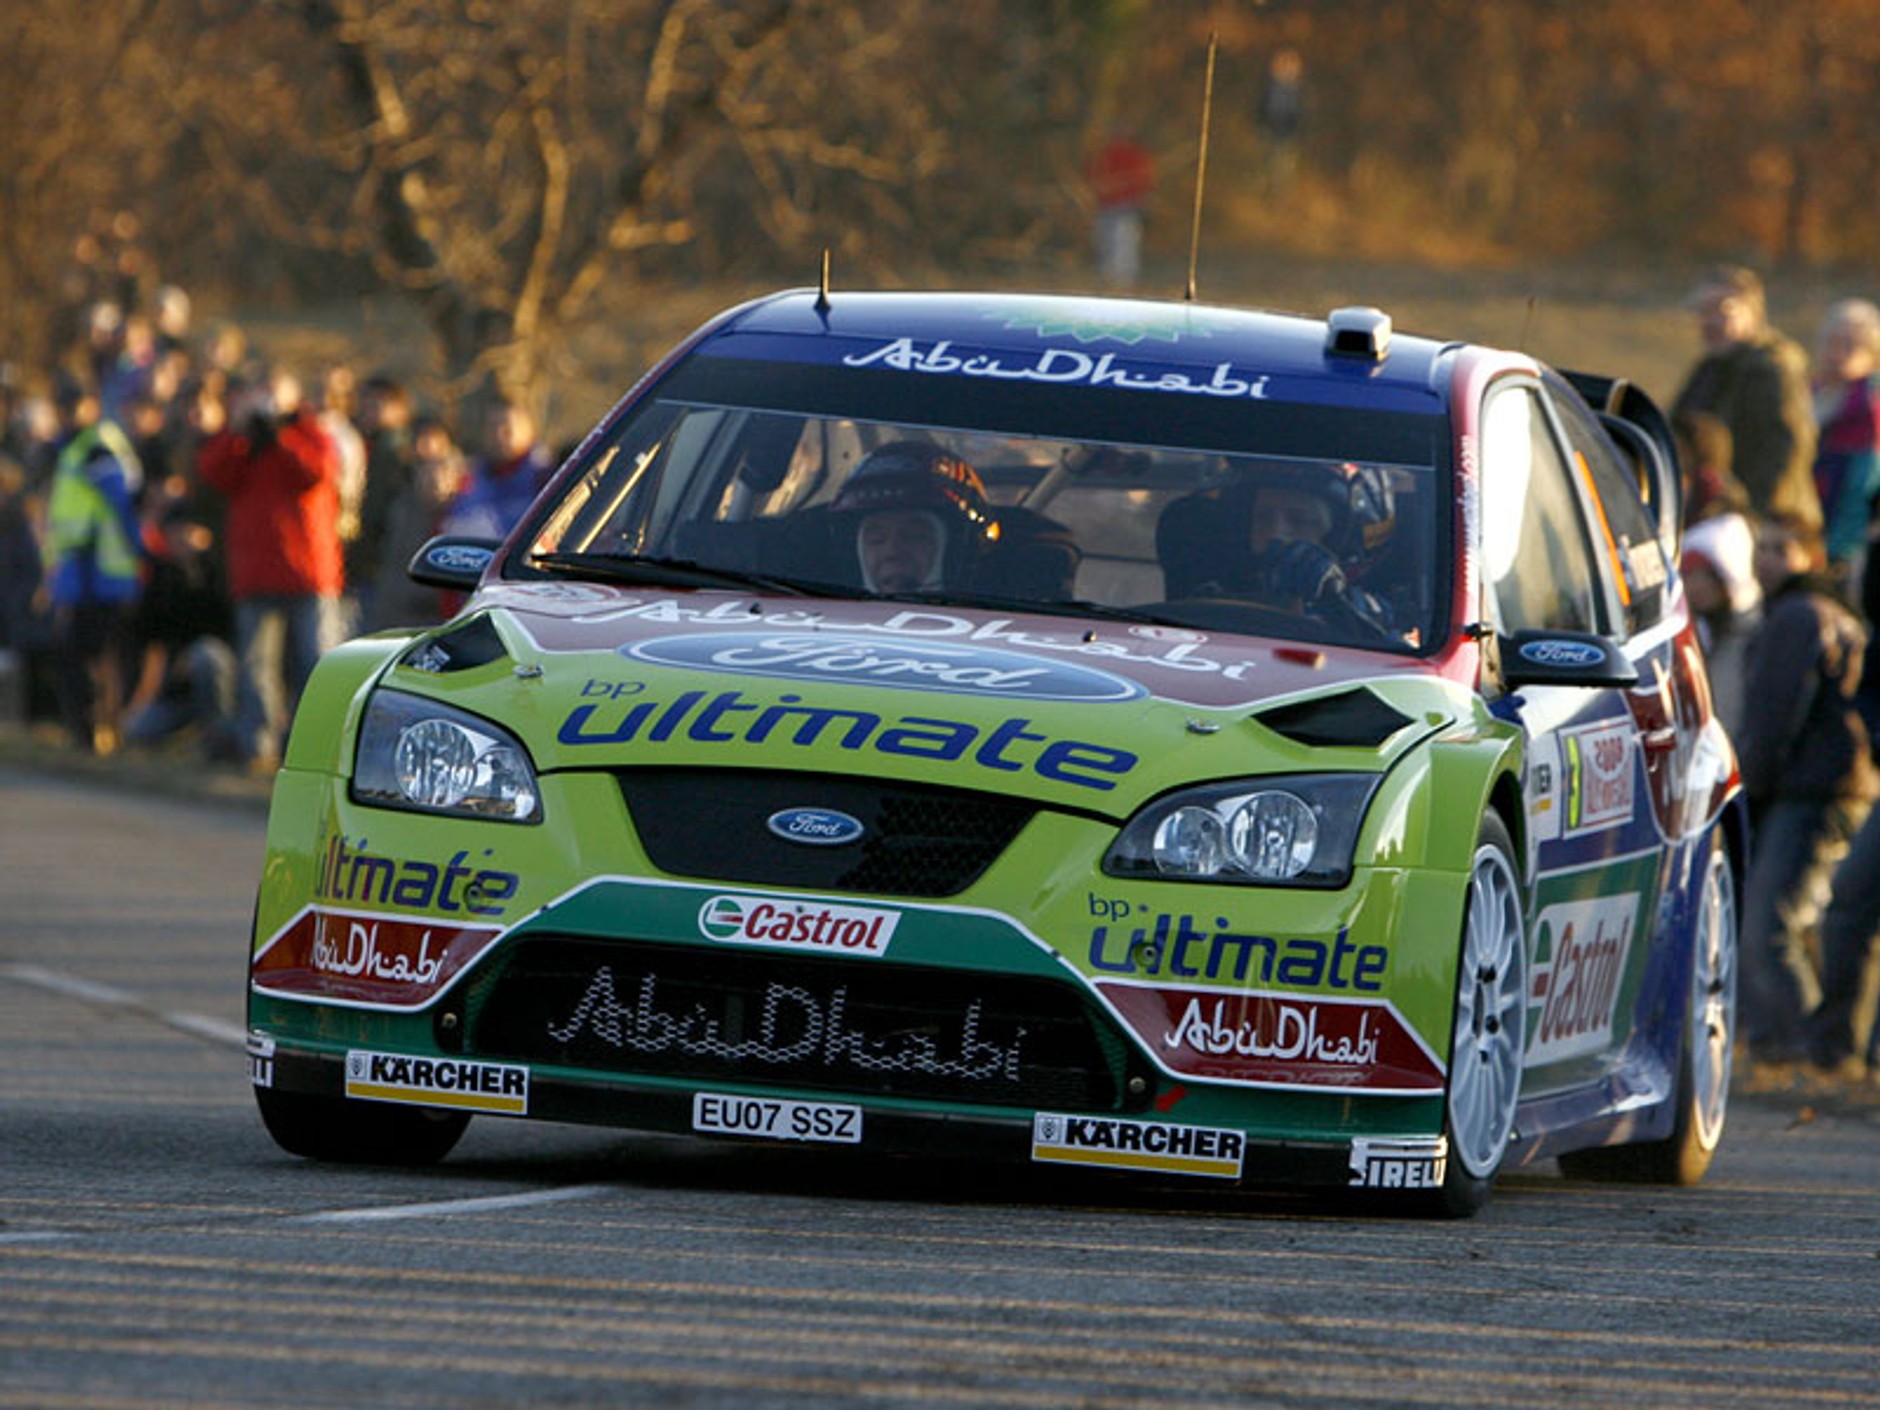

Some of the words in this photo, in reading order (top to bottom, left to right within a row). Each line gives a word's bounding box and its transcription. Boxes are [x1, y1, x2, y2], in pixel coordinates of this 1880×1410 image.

[712, 637, 1051, 690] Ford
[1533, 642, 1591, 664] Ford
[580, 678, 646, 699] bp
[556, 691, 1138, 791] ultimate
[786, 815, 842, 838] Ford
[745, 903, 884, 949] Castrol
[1089, 892, 1130, 922] bp
[1089, 914, 1388, 990] ultimate
[1540, 917, 1630, 1043] Castrol
[370, 1055, 525, 1096] KÄRCHER
[699, 1100, 783, 1134] EU07
[791, 1107, 857, 1138] SSZ
[1065, 1118, 1243, 1160] KÄRCHER
